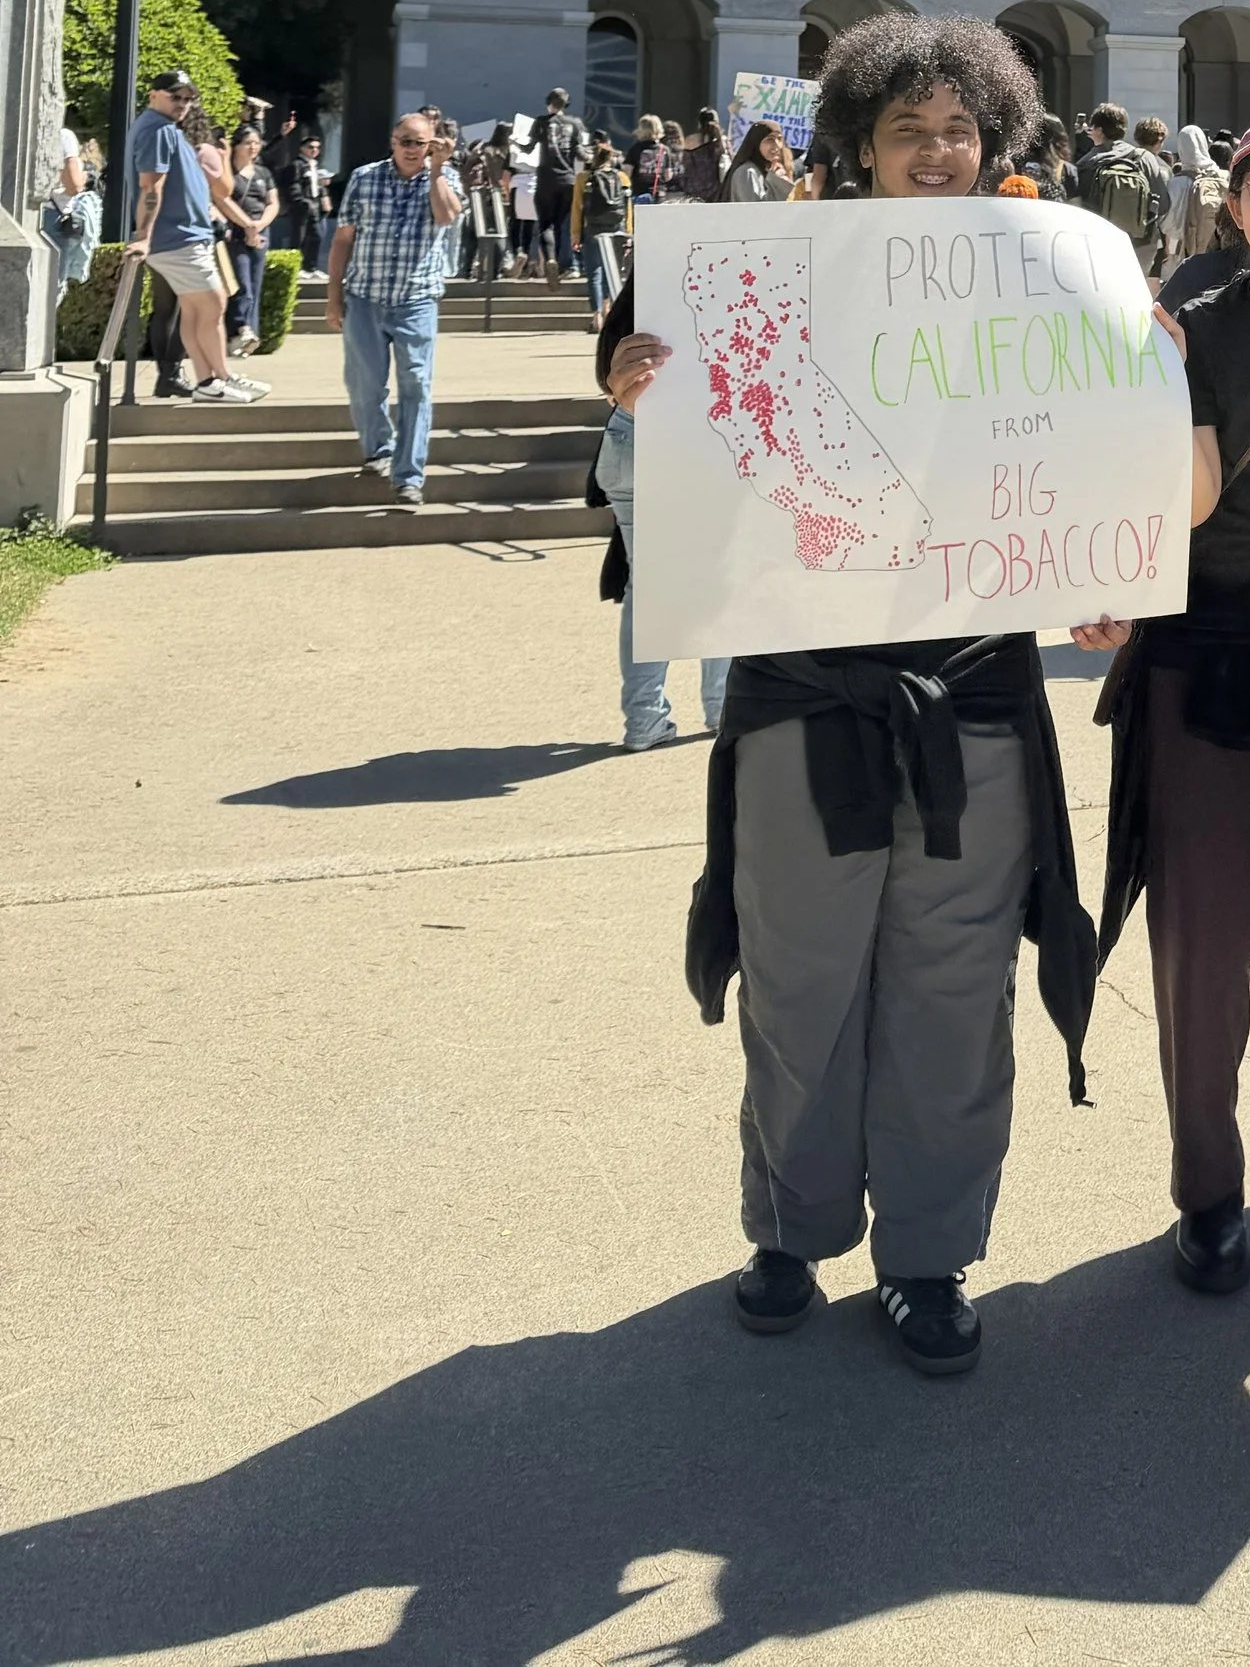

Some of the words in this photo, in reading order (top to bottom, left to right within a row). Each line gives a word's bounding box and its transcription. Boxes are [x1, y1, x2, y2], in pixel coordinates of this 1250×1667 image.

[738, 84, 812, 116] EXAMP
[887, 230, 1099, 307] PROTECT
[870, 307, 1168, 407] CALIFORNIA
[991, 411, 1055, 439] FROM
[991, 461, 1057, 520] BIG
[927, 513, 1164, 604] TOBACCO!
